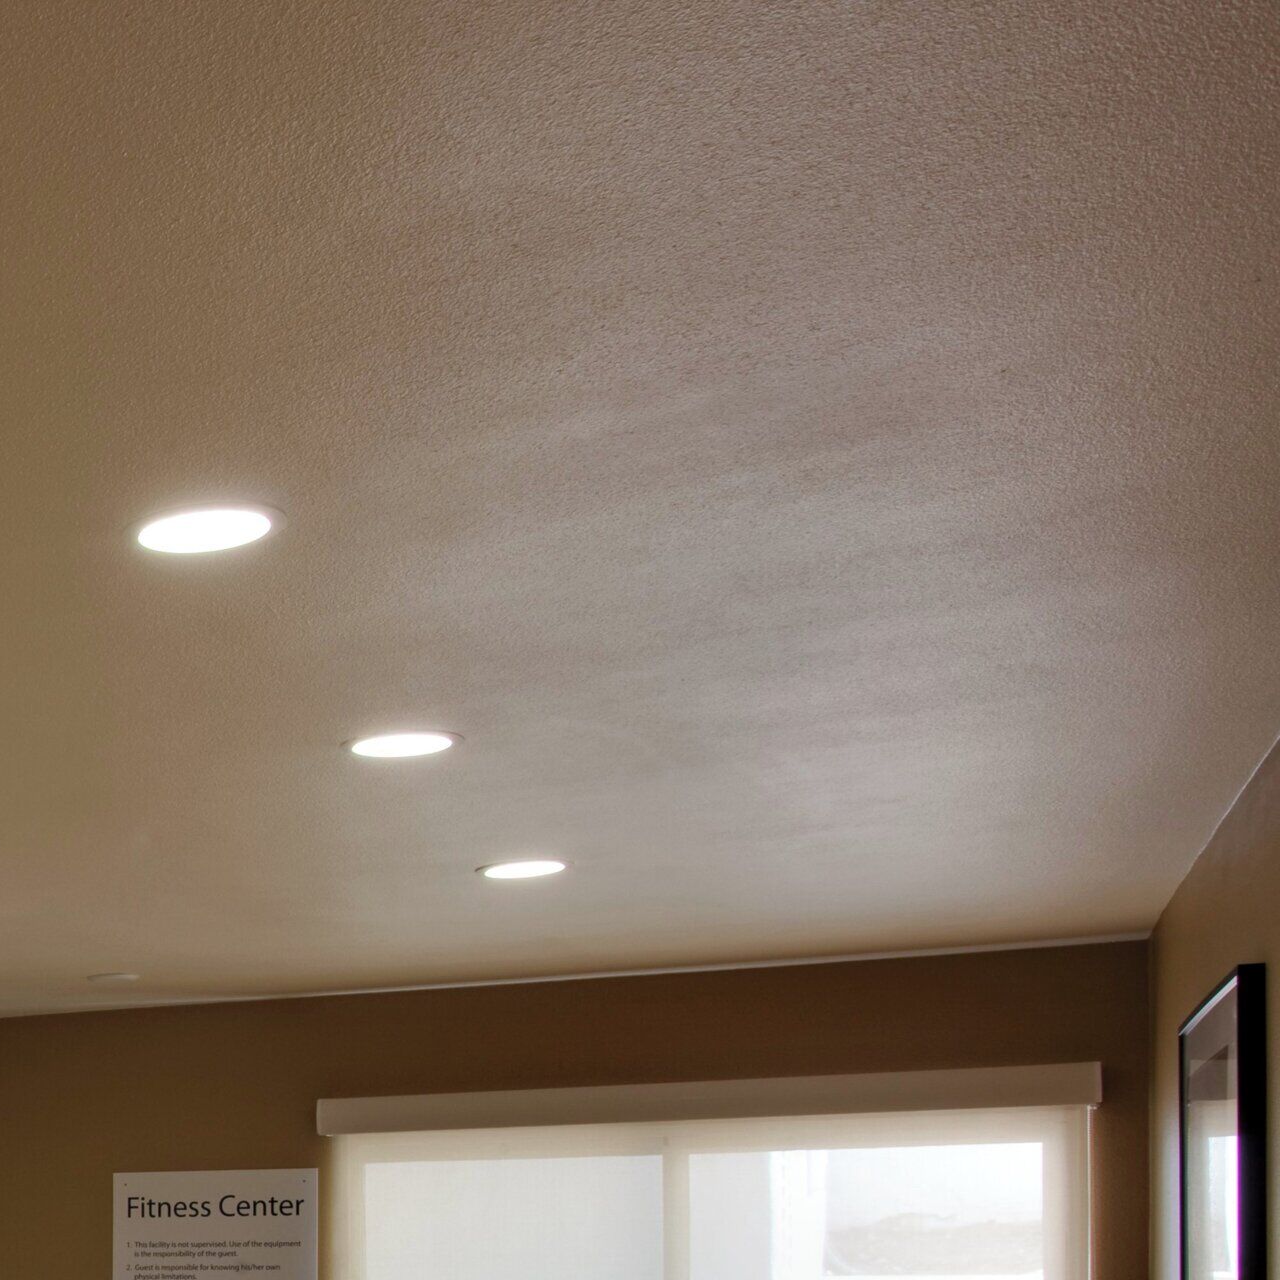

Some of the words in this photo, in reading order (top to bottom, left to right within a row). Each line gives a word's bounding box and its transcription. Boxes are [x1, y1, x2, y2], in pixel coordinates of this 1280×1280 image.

[127, 1197, 211, 1218] Fitness
[219, 1195, 304, 1217] Center
[149, 1241, 170, 1249] facility
[263, 1241, 301, 1249] equipment
[153, 1251, 196, 1259] responsibility
[218, 1251, 238, 1259] guest.
[161, 1264, 198, 1272] responsible
[211, 1264, 240, 1272] knowing
[134, 1273, 160, 1280] physical
